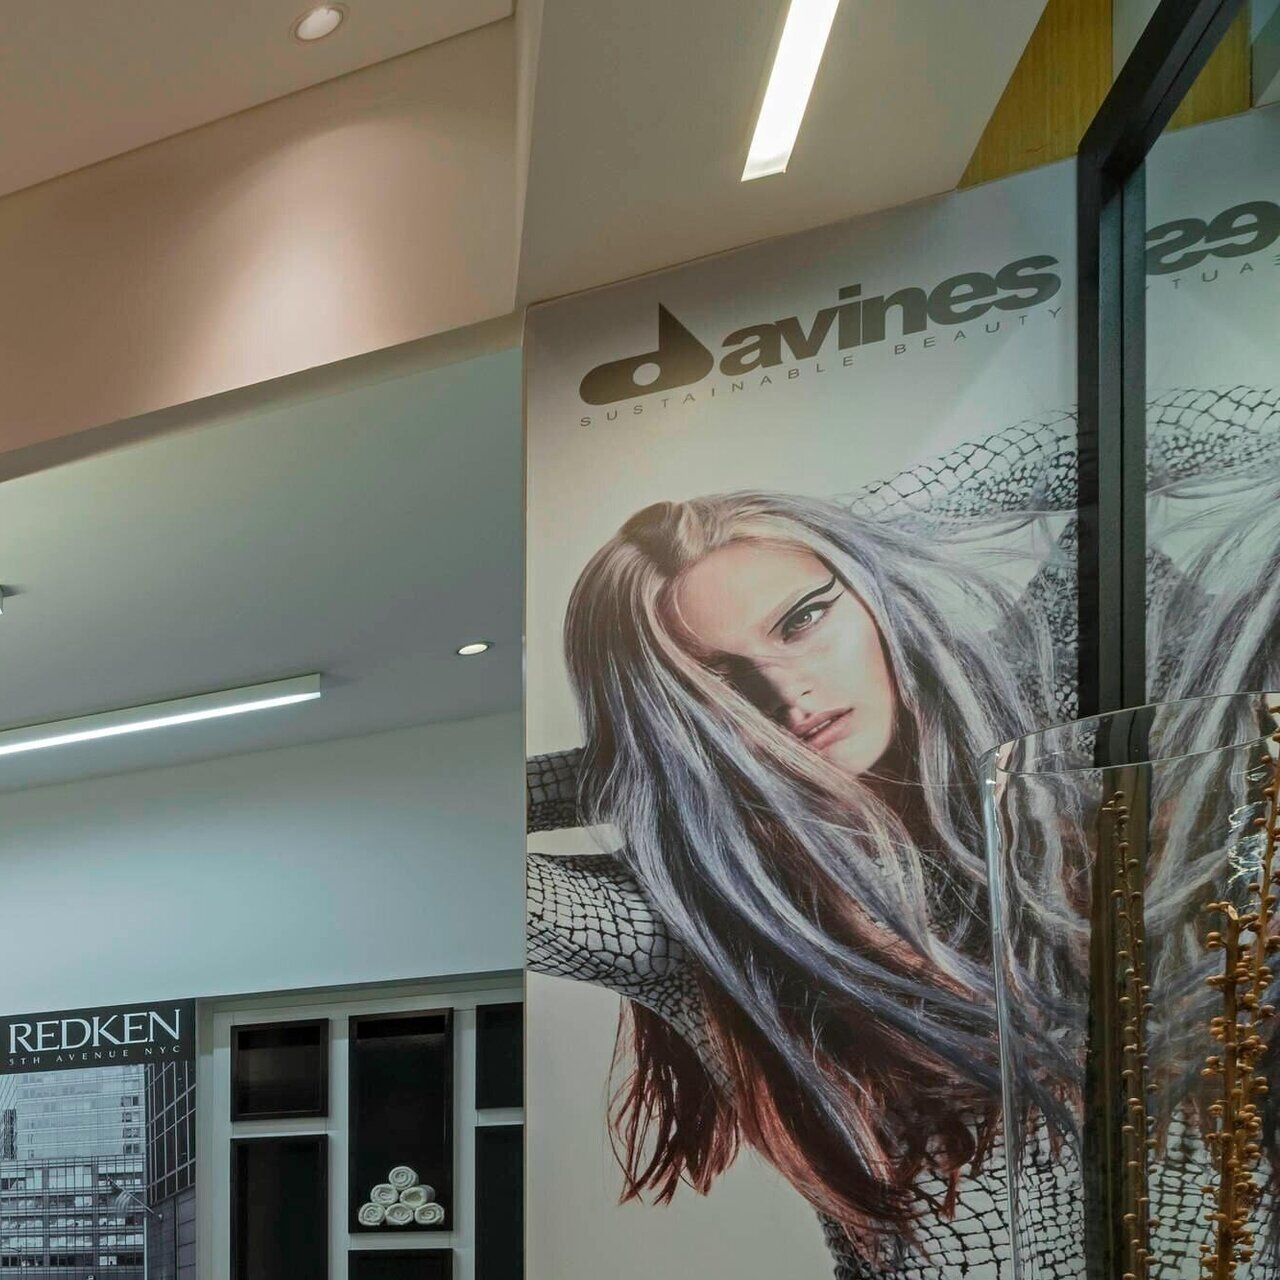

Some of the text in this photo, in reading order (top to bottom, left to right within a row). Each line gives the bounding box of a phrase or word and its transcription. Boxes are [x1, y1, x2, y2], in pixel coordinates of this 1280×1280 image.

[579, 253, 1063, 406] davines
[579, 304, 1064, 428] SUSTAINABLE BEAUTY
[8, 1008, 182, 1054] REDKEN
[9, 1044, 181, 1066] 5TH AVENUE NYC
